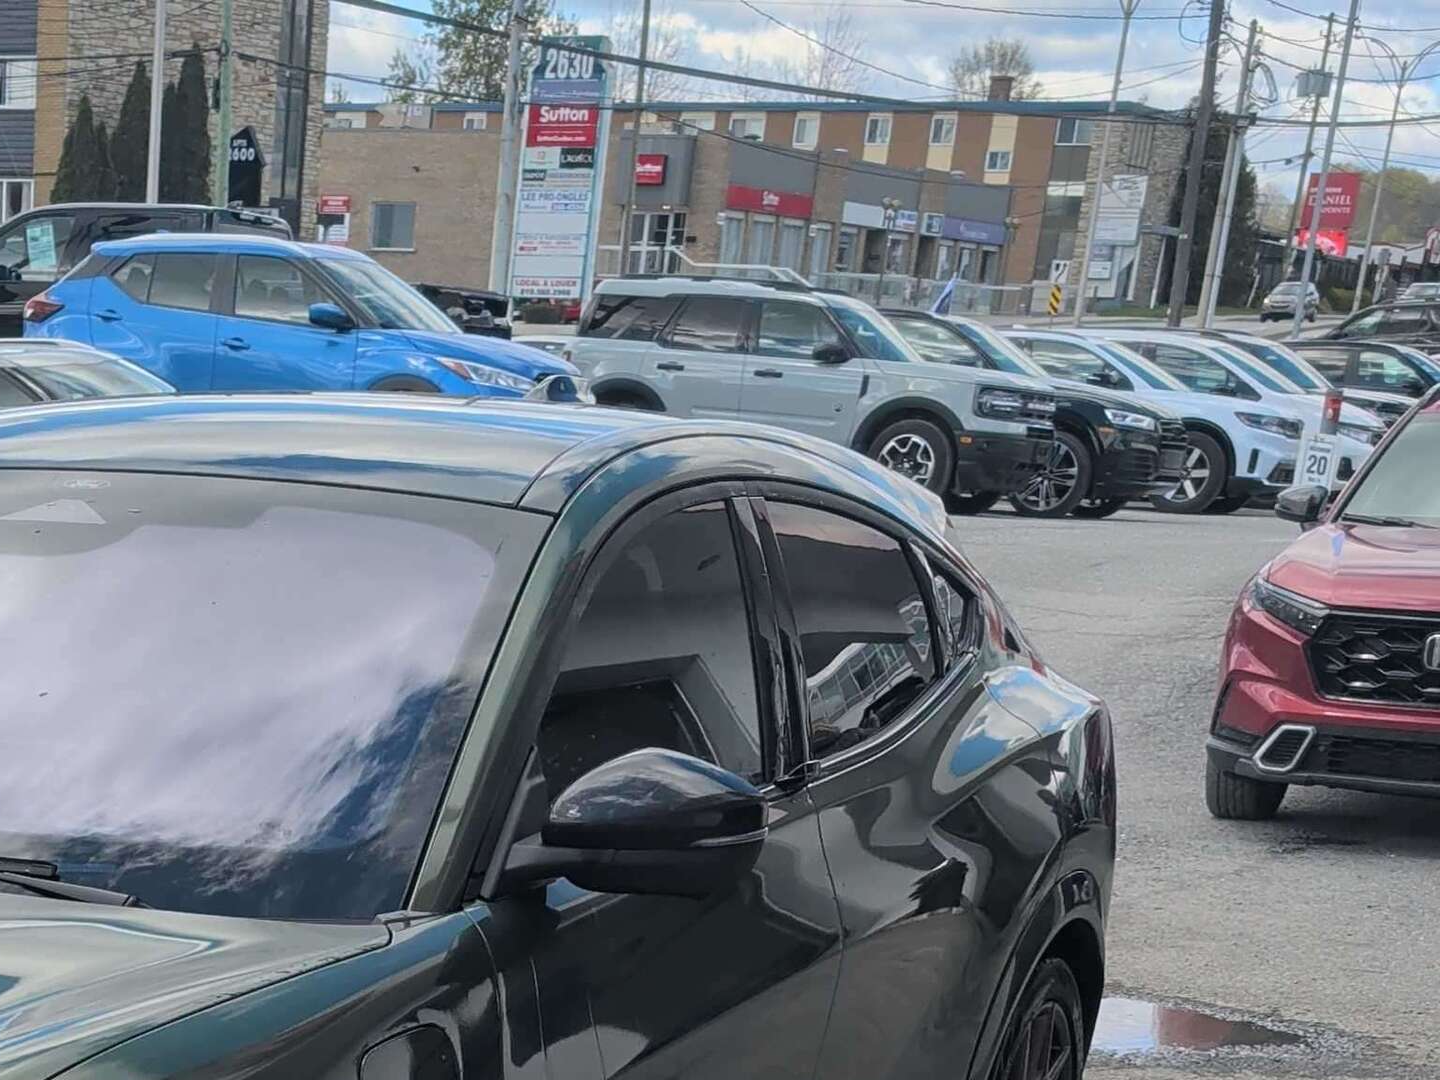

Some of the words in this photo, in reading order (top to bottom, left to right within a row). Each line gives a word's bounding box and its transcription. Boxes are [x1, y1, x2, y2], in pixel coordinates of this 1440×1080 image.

[544, 48, 595, 79] 2630
[539, 106, 589, 123] Sutton
[1306, 454, 1329, 476] 20
